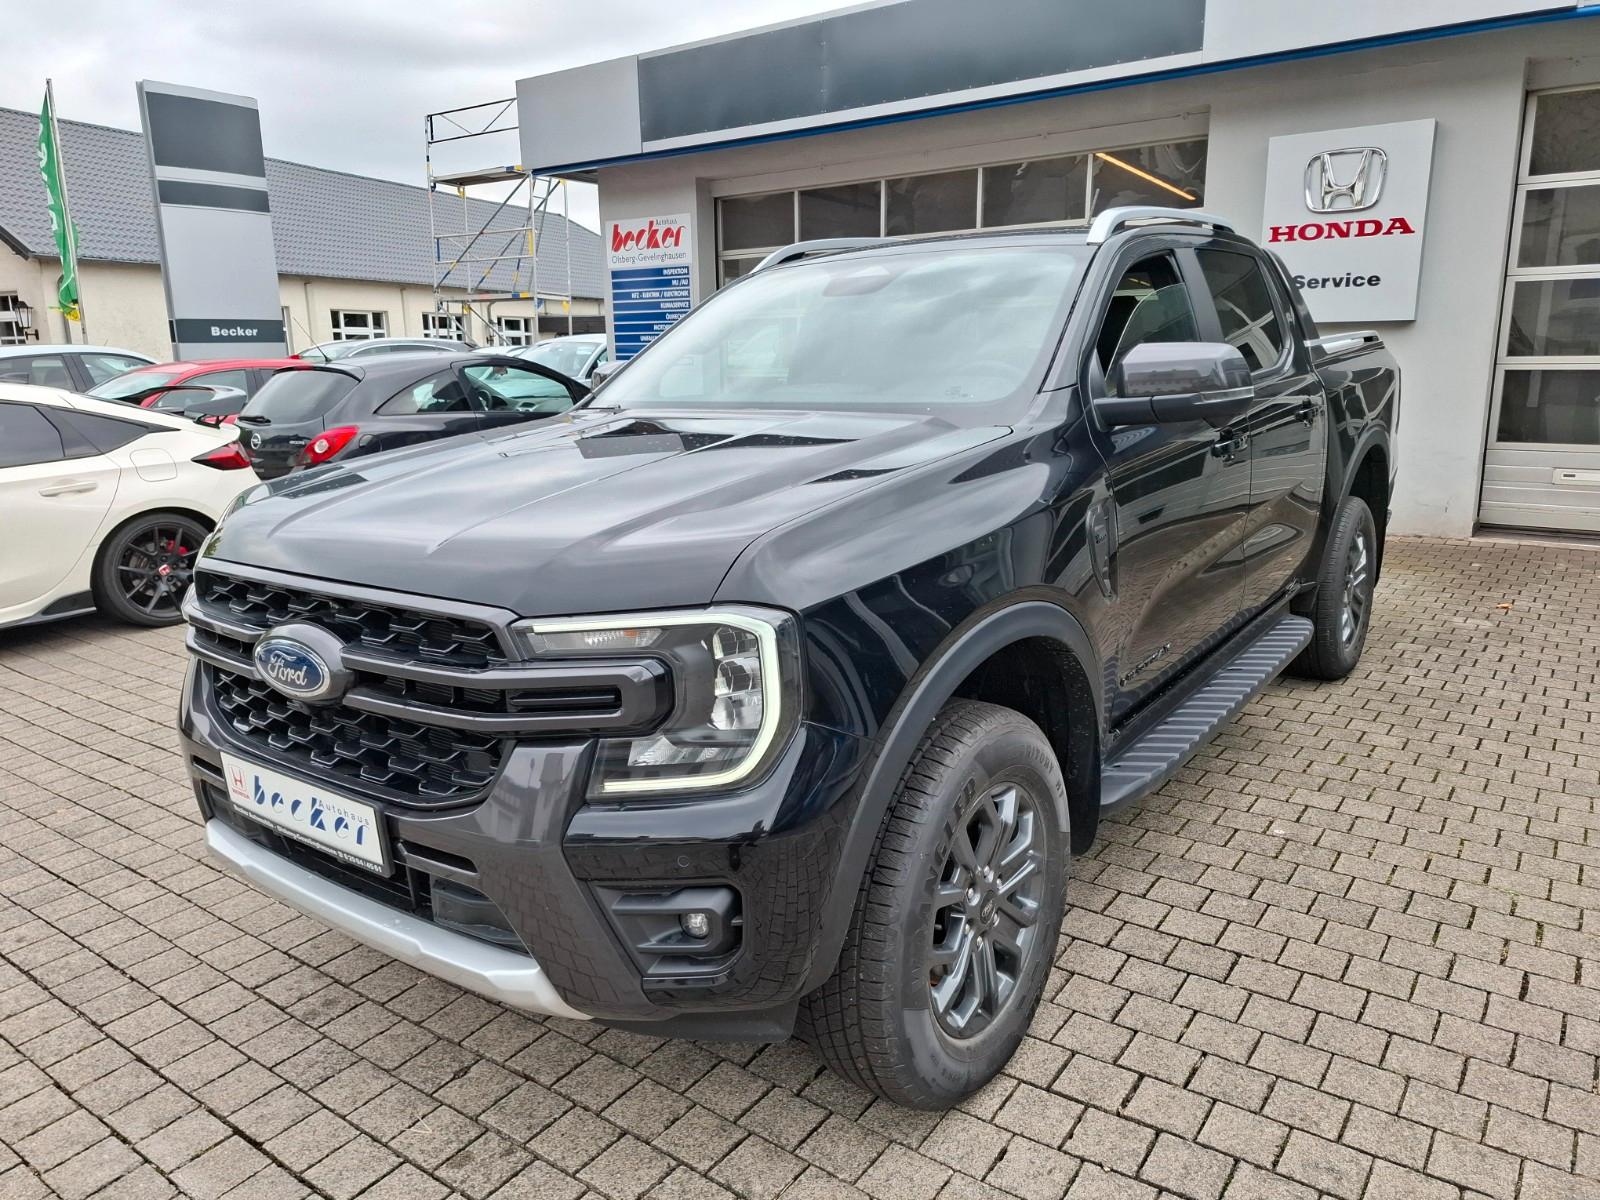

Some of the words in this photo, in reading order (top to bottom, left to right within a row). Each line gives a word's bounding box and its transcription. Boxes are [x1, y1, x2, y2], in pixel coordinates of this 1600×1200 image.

[612, 220, 687, 253] becker
[1269, 217, 1415, 243] HONDA
[662, 267, 688, 276] INSPEKTION
[1293, 272, 1382, 290] Service
[210, 326, 258, 337] Becker
[267, 650, 308, 686] Ford
[254, 775, 371, 846] becker
[319, 799, 370, 827] Autohaus
